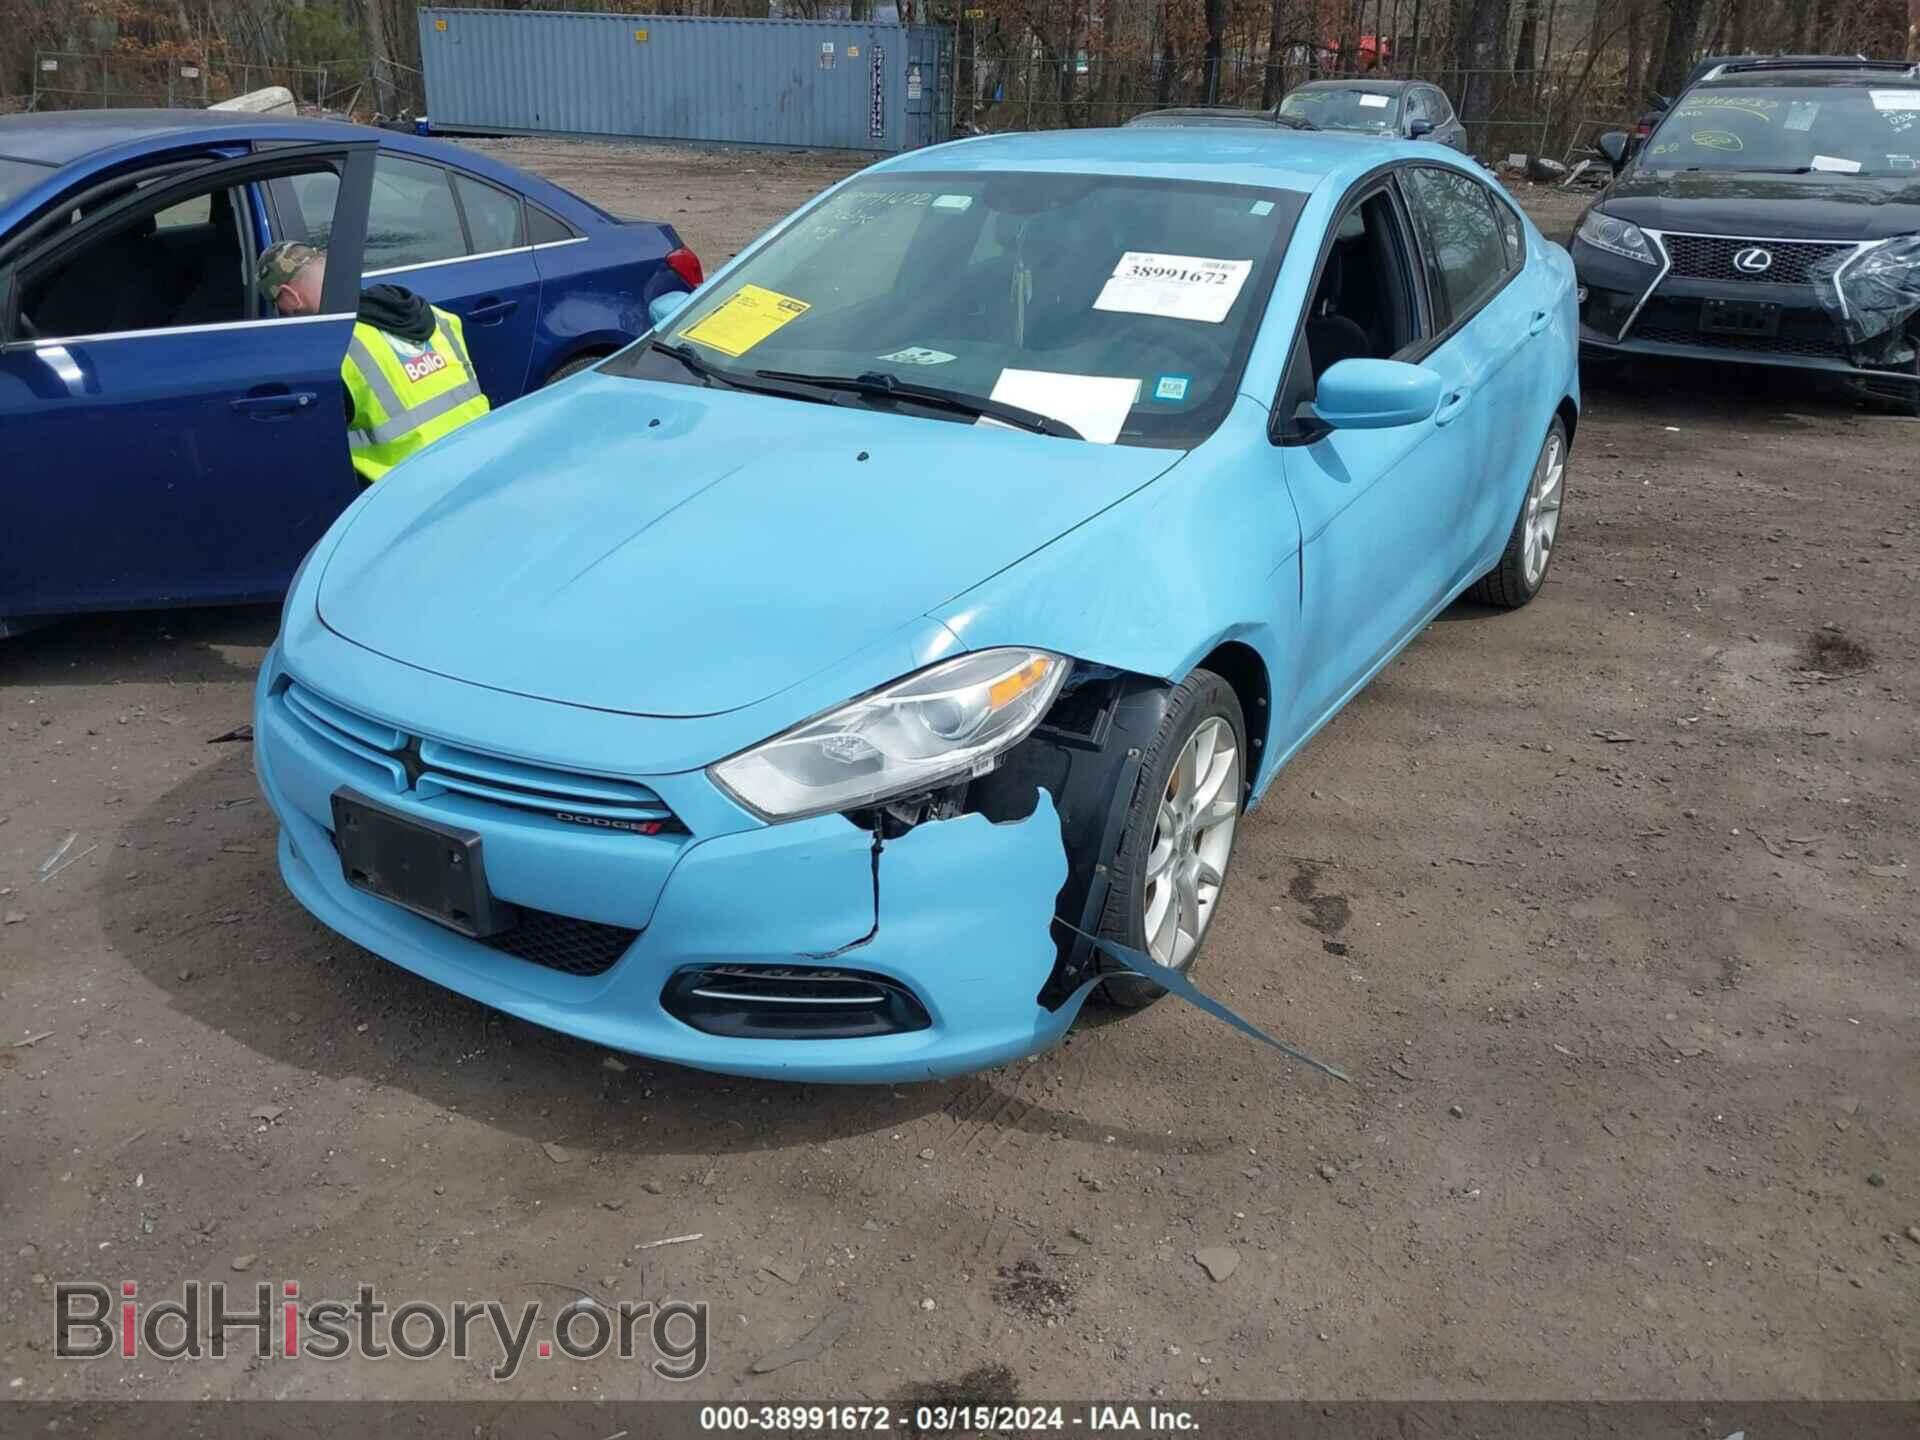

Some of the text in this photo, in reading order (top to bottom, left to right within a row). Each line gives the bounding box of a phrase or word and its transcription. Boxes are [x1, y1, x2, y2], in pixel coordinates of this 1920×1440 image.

[1126, 265, 1229, 285] 38991672
[405, 354, 444, 380] Bolla
[557, 812, 648, 832] DODGE
